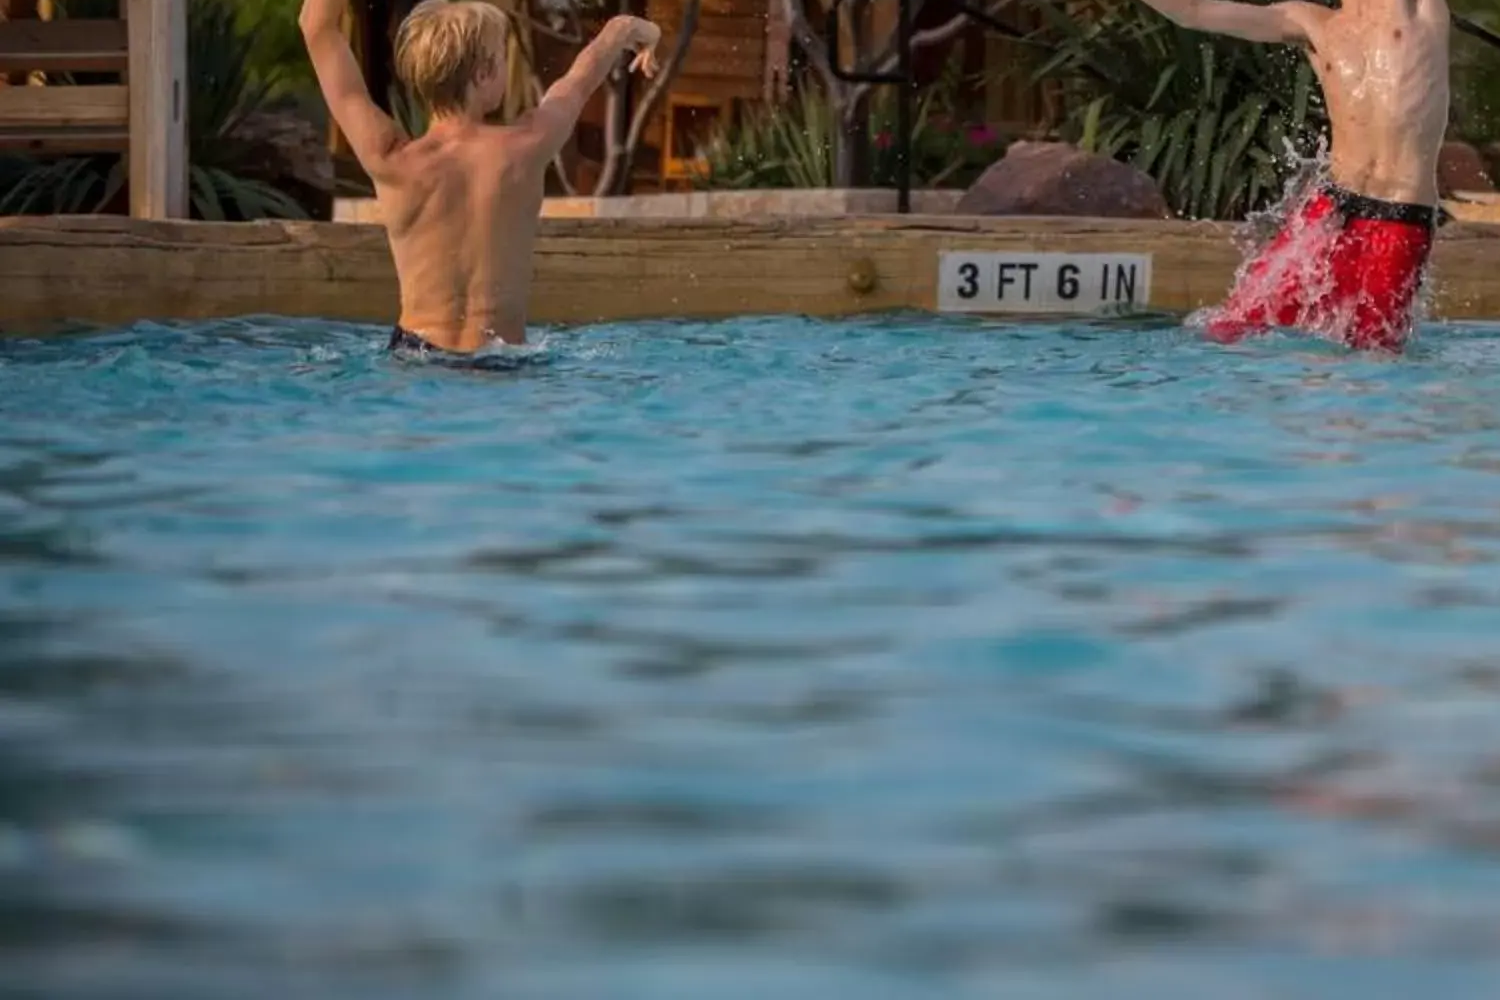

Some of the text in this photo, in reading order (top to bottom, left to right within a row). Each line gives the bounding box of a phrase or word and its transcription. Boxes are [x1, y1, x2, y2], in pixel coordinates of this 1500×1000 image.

[957, 262, 1136, 301] 3 FT 6 IN
